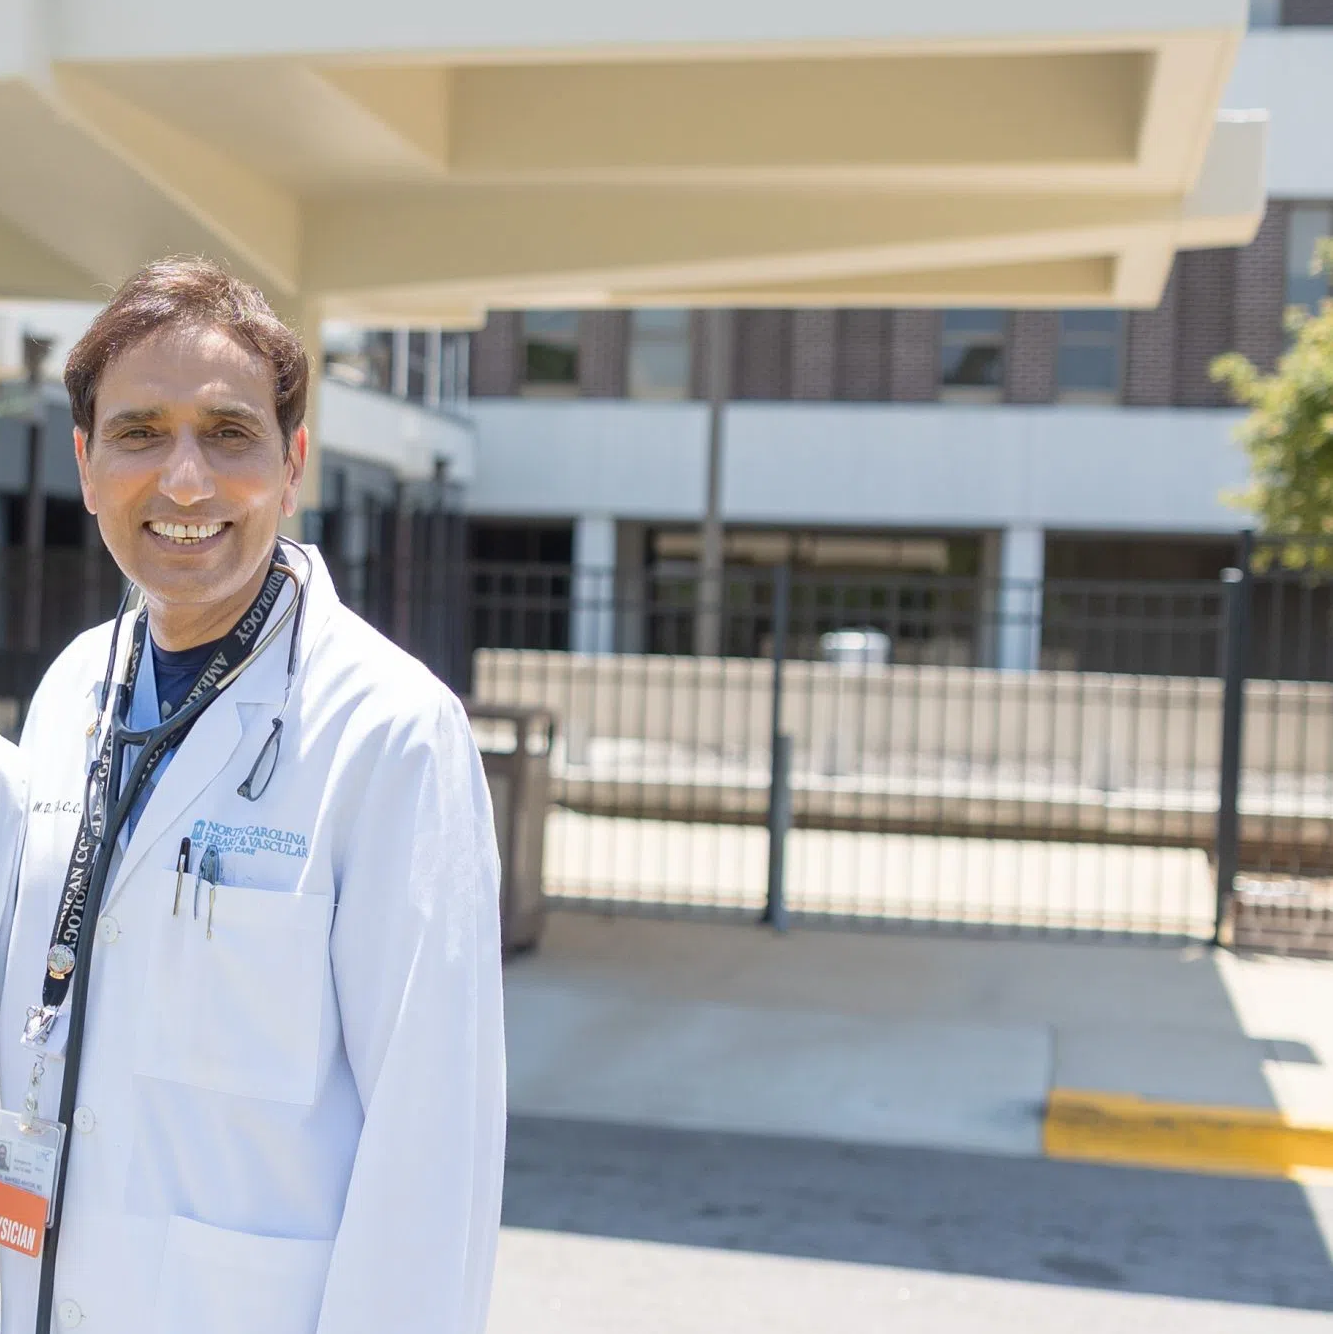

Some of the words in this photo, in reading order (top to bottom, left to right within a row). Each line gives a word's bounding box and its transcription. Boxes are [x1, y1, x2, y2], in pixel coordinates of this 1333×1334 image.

[203, 832, 239, 846] HEART
[239, 835, 247, 846] &
[249, 836, 308, 858] VASCULAR
[207, 821, 245, 837] NORTH
[246, 825, 306, 846] CAROLINA
